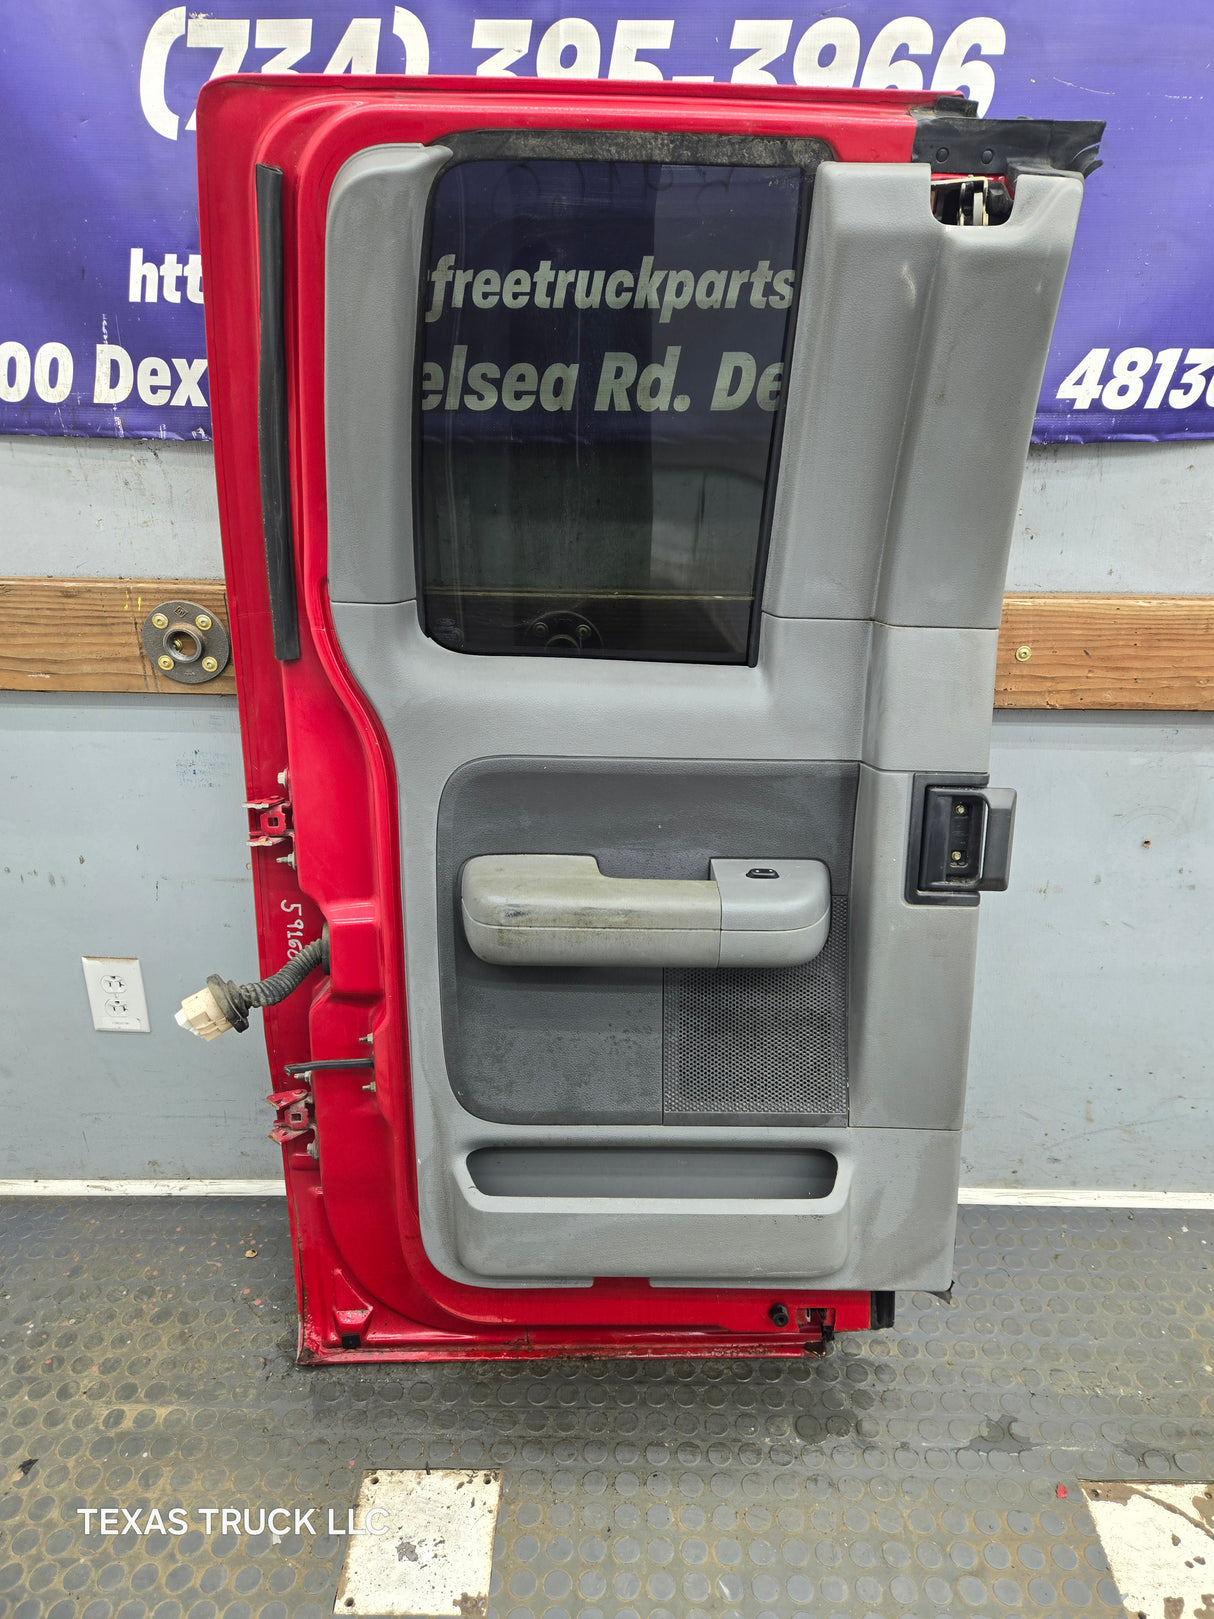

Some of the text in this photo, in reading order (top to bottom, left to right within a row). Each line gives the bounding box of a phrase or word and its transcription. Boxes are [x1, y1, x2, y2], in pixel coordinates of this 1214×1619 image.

[129, 248, 205, 304] htt
[0, 341, 1214, 412] 00 Dex elsea Rd. De 4813
